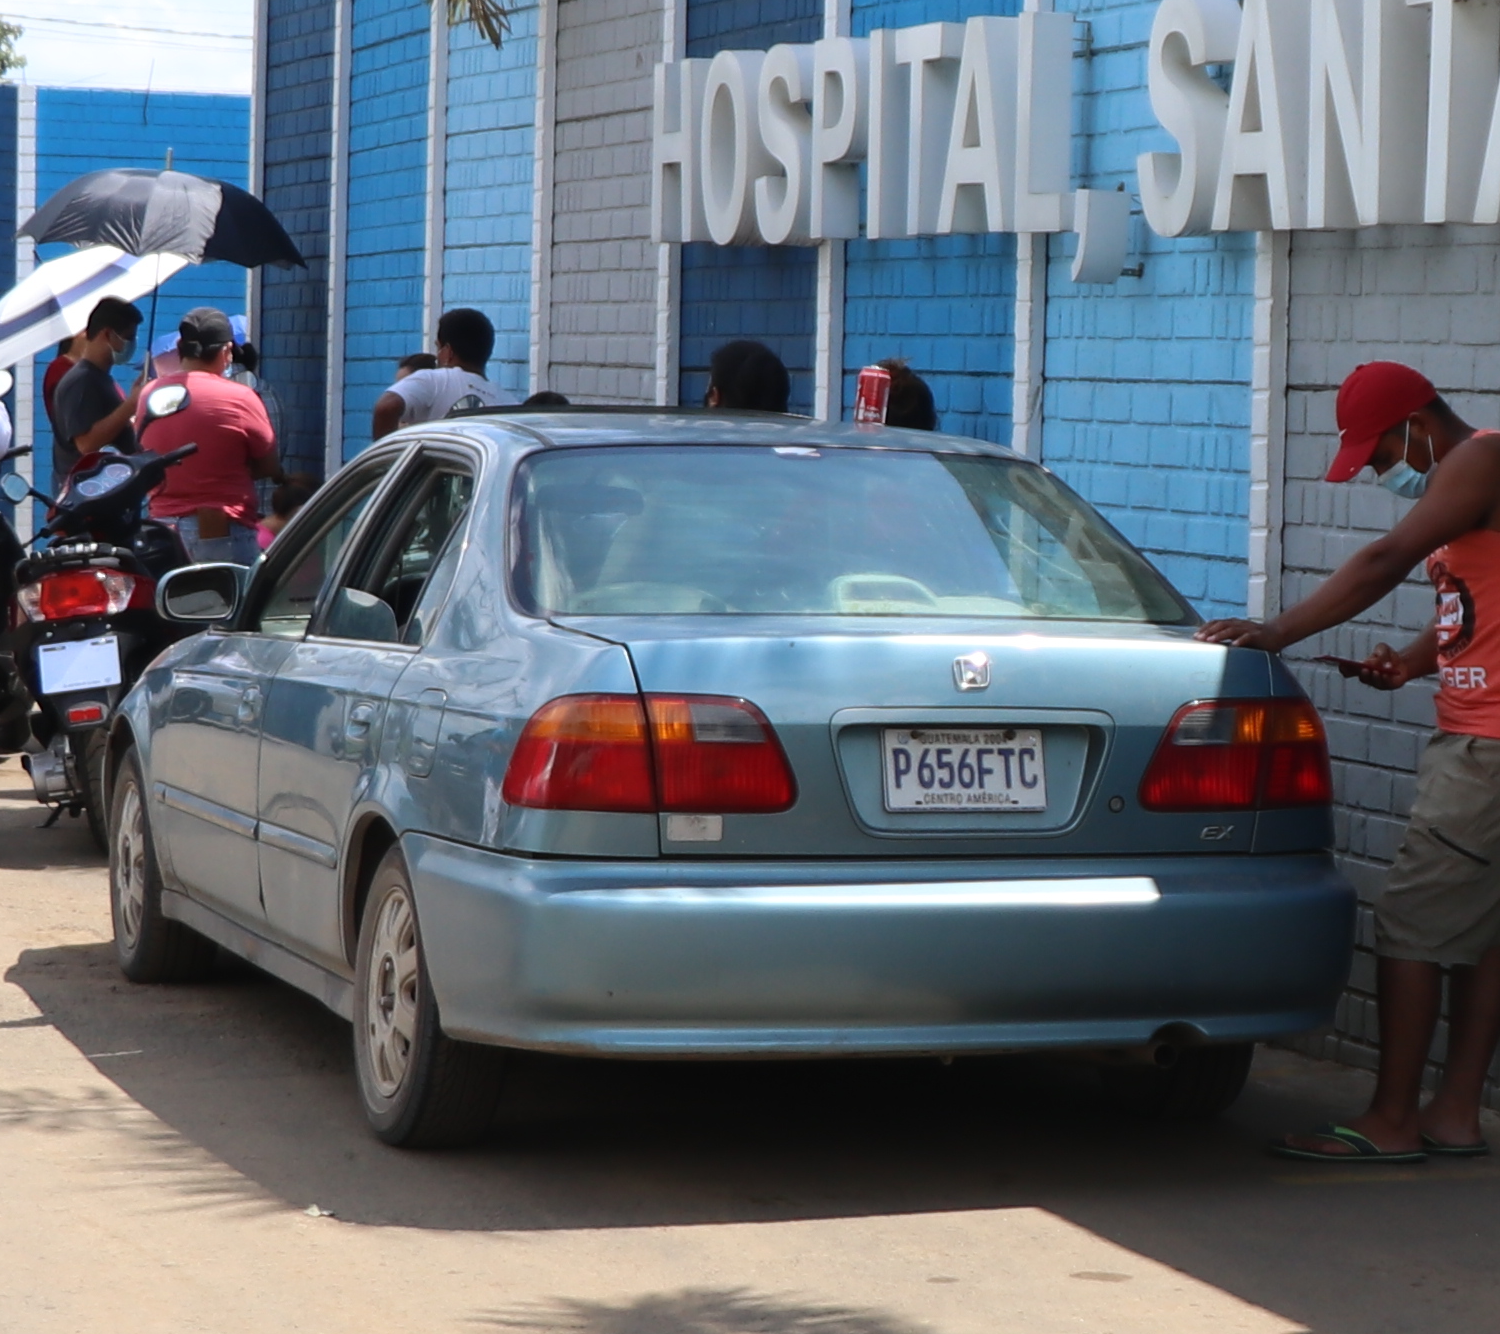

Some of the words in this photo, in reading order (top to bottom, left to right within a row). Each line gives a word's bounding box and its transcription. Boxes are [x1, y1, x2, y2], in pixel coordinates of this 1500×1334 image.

[1441, 666, 1488, 689] GER
[920, 732, 980, 745] GUATEMALA
[923, 793, 963, 805] CENTRO
[966, 791, 1011, 805] AMÉRICA
[1200, 825, 1234, 840] EX
